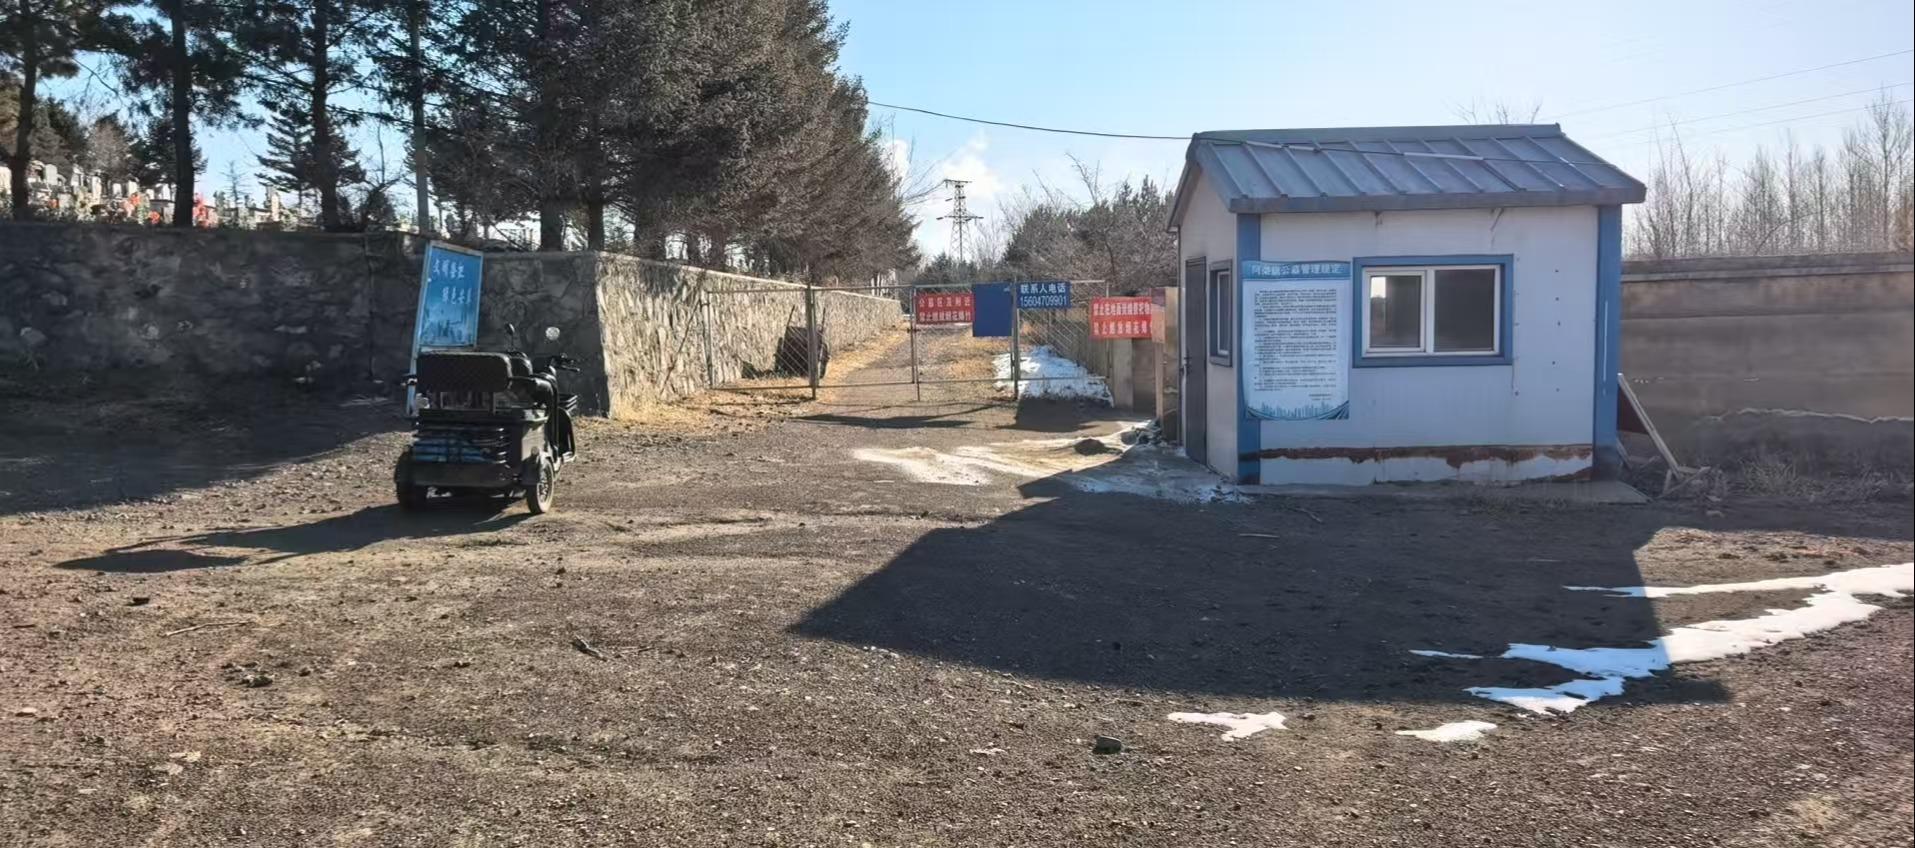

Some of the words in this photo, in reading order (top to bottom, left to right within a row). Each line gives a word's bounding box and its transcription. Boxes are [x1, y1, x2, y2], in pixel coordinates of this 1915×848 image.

[1251, 263, 1345, 275] 阿荣旗公墓管理规定
[1020, 283, 1066, 294] 联系人电话
[919, 297, 971, 308] 公墓区及附近
[1020, 296, 1067, 307] 15604709901
[1093, 302, 1152, 316] 禁止在地面焚烧祭祀物
[919, 311, 971, 322] 禁止燃放烟花爆竹
